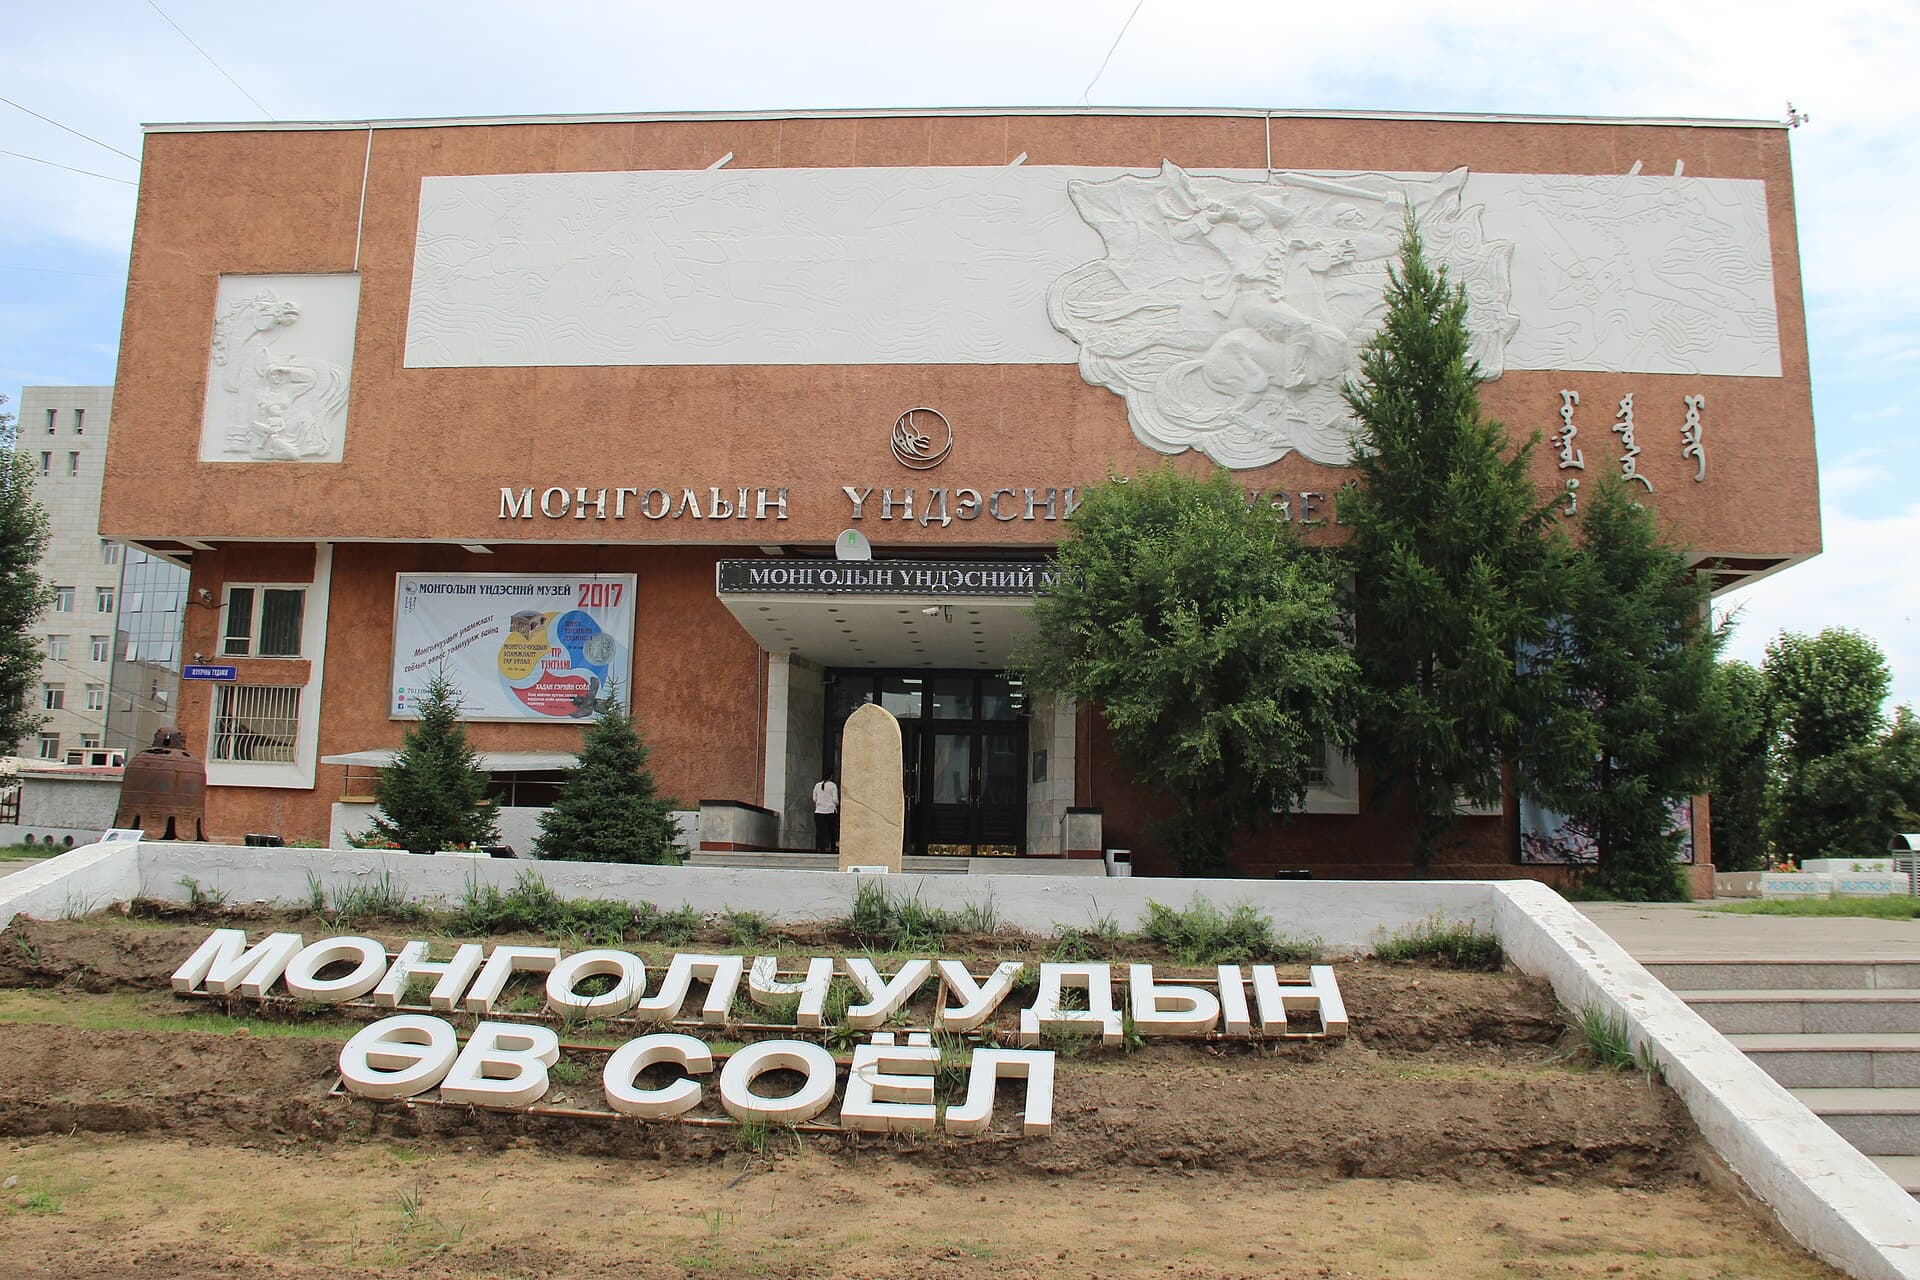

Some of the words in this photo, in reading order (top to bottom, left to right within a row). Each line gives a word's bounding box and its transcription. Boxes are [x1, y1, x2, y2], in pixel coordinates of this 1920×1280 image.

[498, 487, 789, 520] МОНГОЛЫН
[419, 583, 476, 594] МОНГОЛЫН
[479, 584, 534, 596] ҮНДЭСНИЙ
[536, 584, 571, 596] МУЗЕЙ
[749, 568, 893, 587] МОНГОЛЫН
[900, 567, 1035, 591] ҮНДЭСНИЙ
[578, 583, 623, 608] 2017
[171, 928, 1349, 1047] МОНГОЛЧУУДЫН
[339, 1014, 560, 1106] ӨВ
[603, 1032, 1055, 1136] СОЁЛ
